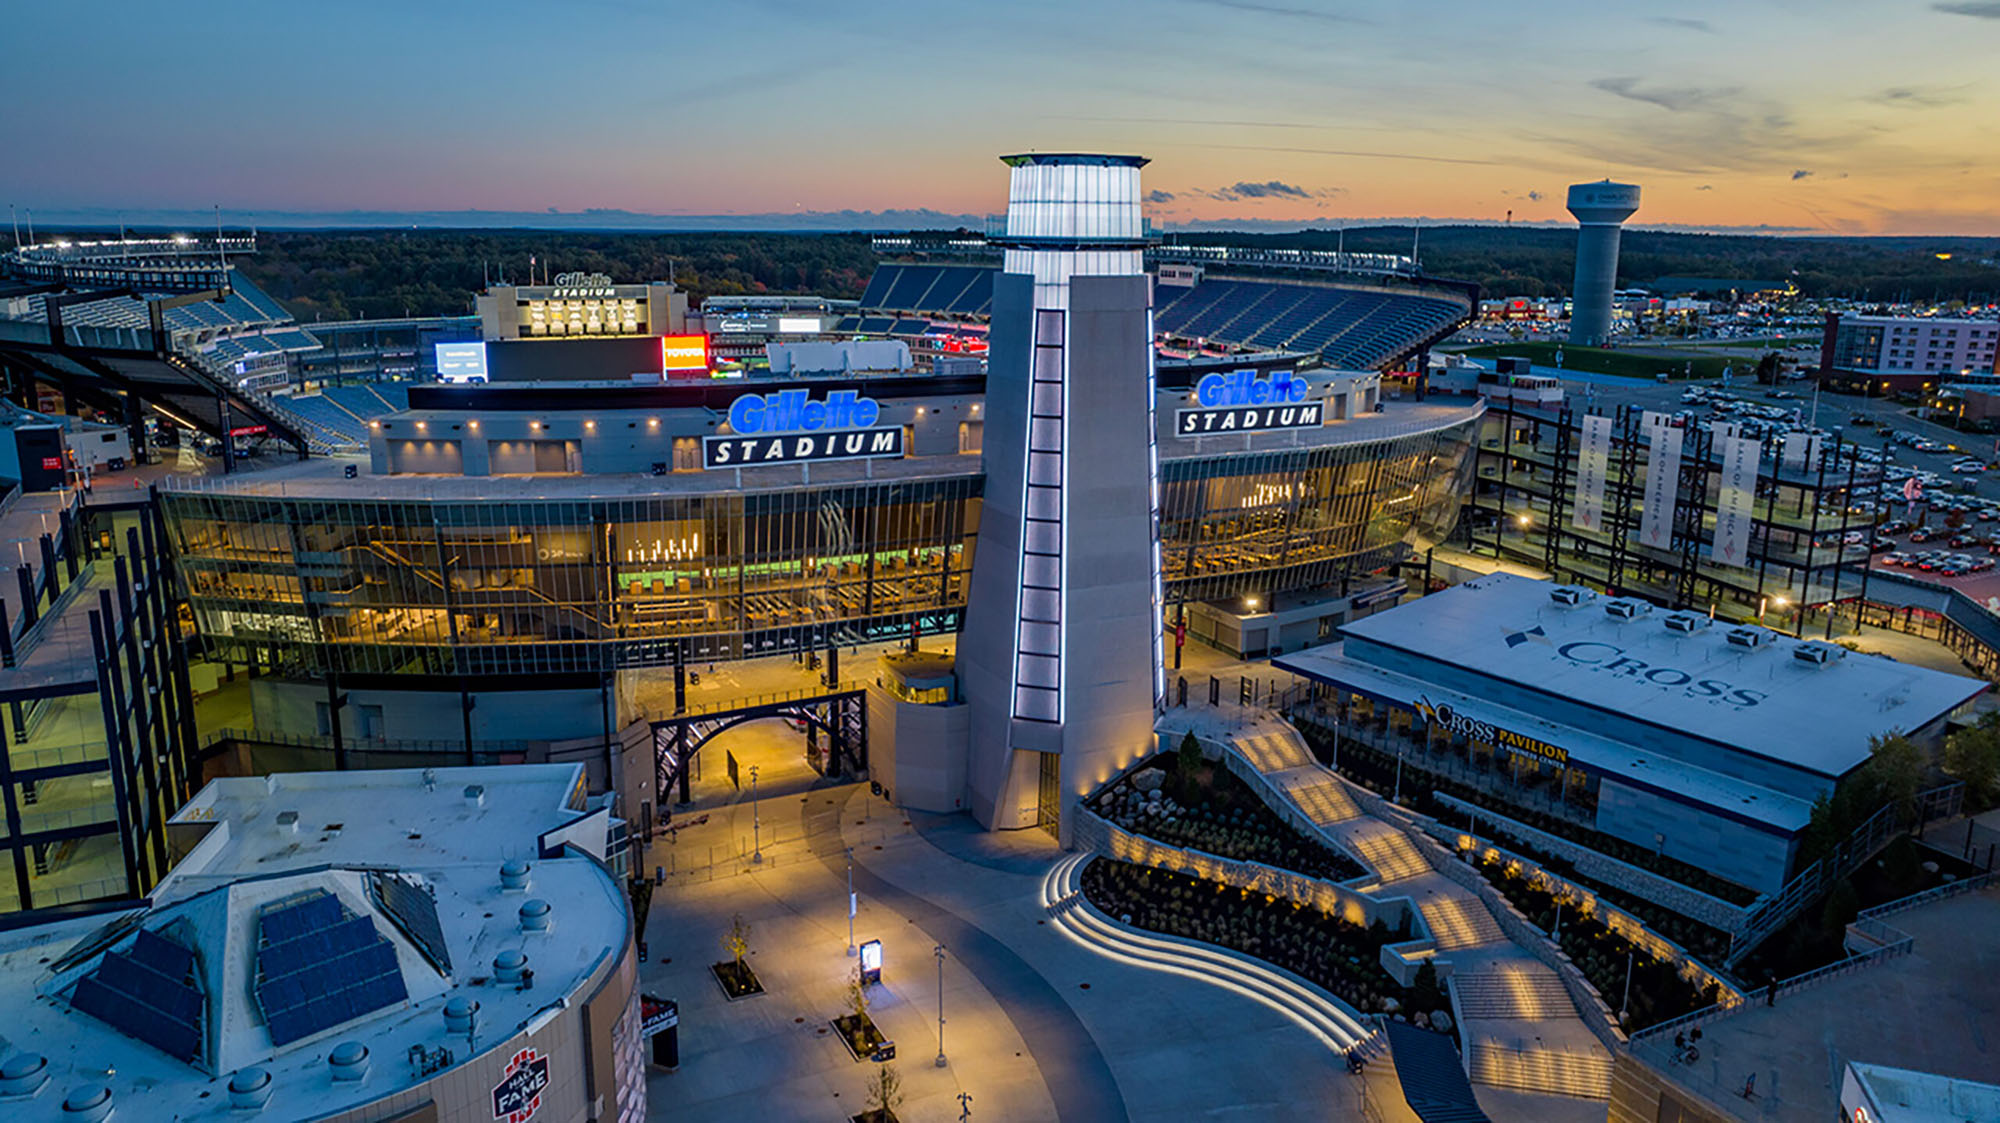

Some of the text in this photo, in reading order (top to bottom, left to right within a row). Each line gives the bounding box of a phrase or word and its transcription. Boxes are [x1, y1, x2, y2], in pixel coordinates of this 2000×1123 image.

[553, 288, 615, 297] STADIUM
[554, 272, 612, 287] Gillette
[1198, 370, 1308, 408] Gillette
[729, 389, 879, 434] Gillette
[1184, 407, 1318, 432] STADIUM
[715, 432, 895, 463] STADIUM
[1584, 463, 1594, 505] AMERICA
[1653, 430, 1669, 520] BANK OF AMERICA
[1726, 441, 1746, 537] BANK OF AMERICA
[1499, 729, 1567, 762] PAVILION
[647, 1008, 675, 1026] FAME
[499, 1070, 546, 1114] FAME
[509, 1069, 535, 1089] HALL
